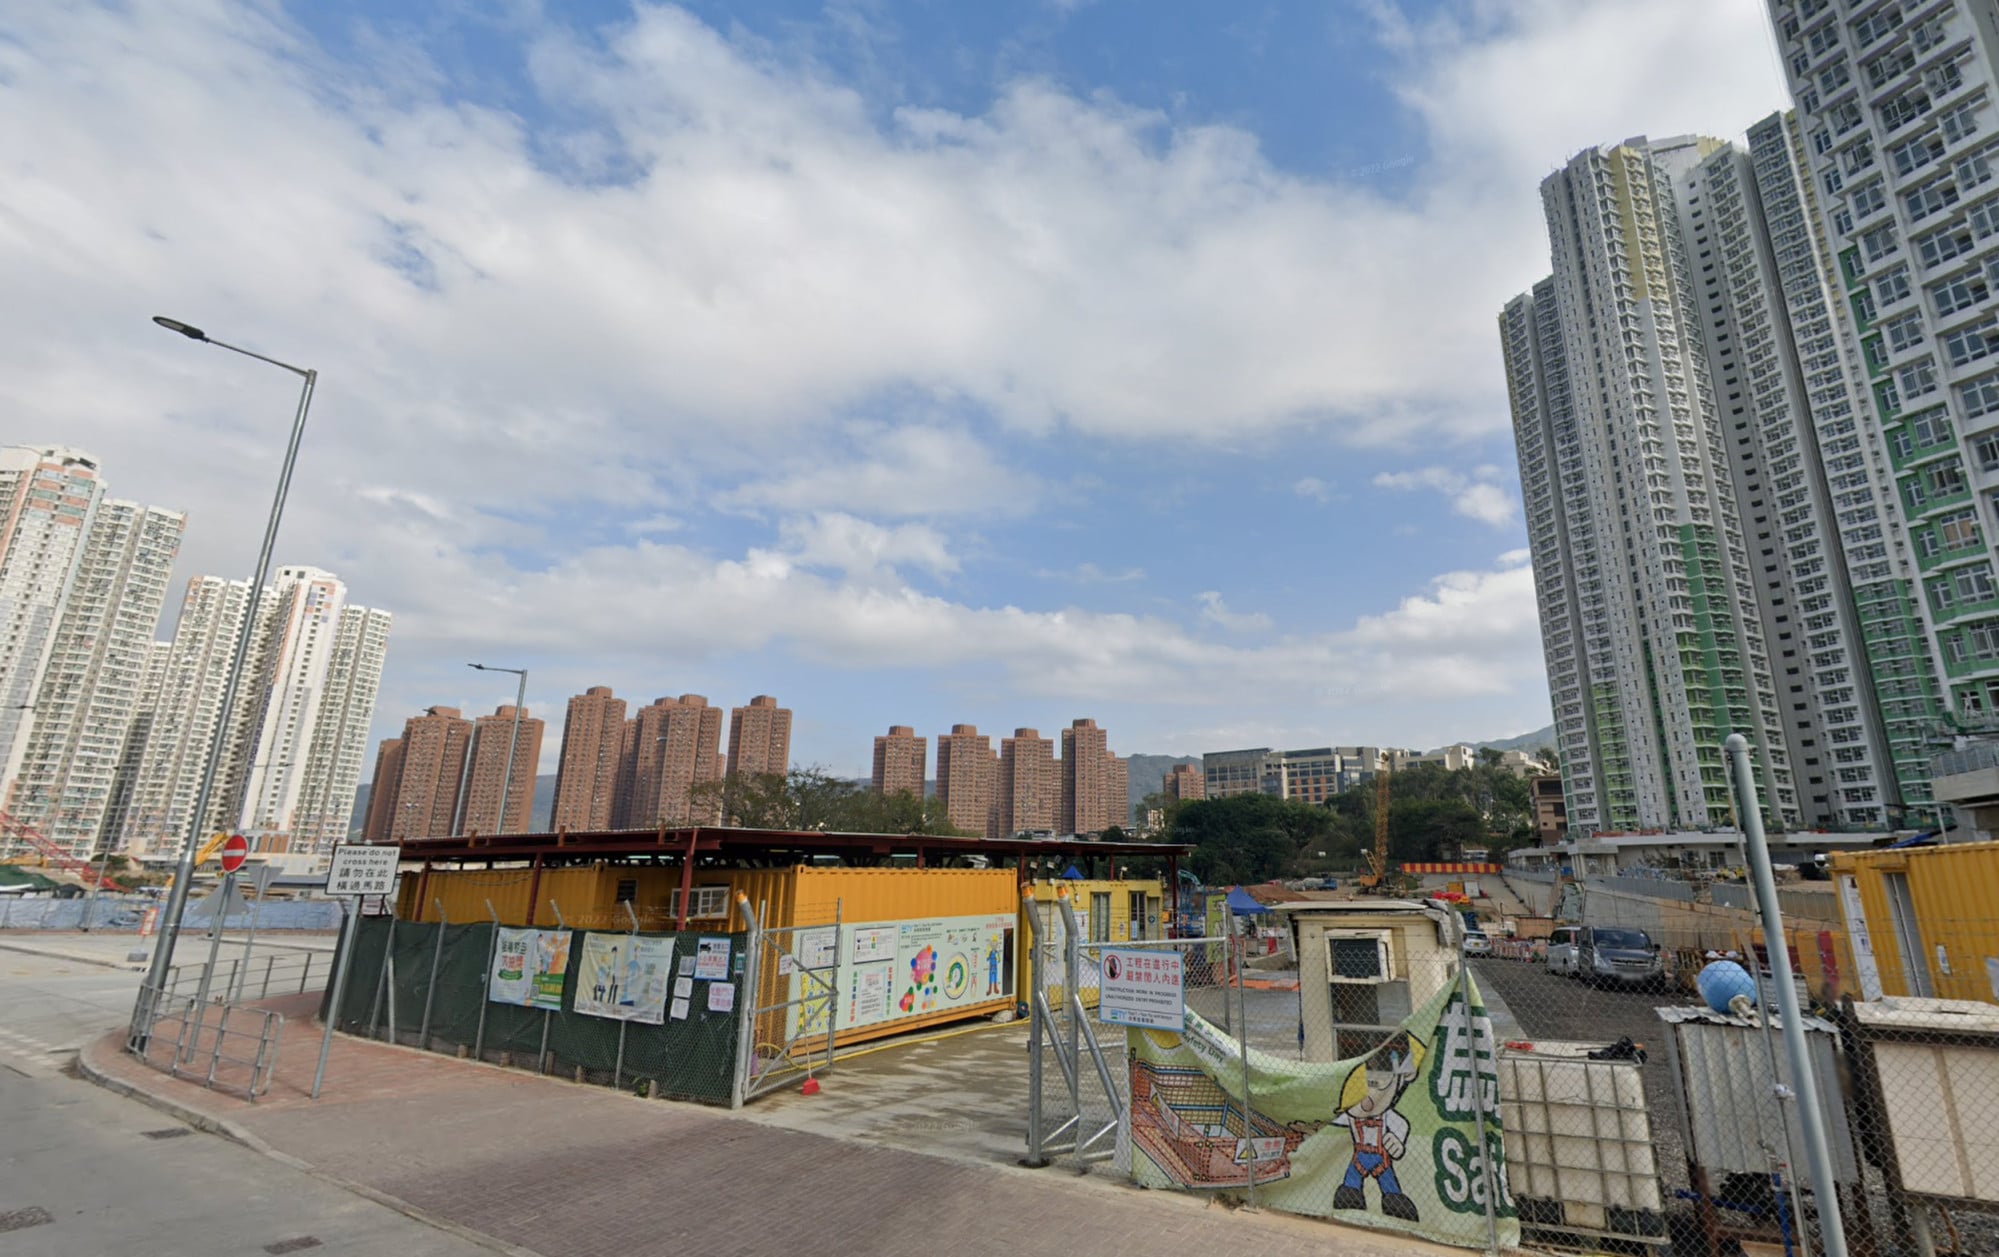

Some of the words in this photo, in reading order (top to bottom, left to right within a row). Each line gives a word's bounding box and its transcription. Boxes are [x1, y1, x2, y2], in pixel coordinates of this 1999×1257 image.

[338, 848, 367, 856] Please
[339, 868, 389, 878] 請勿在此
[1126, 957, 1179, 970] 工程在進行中
